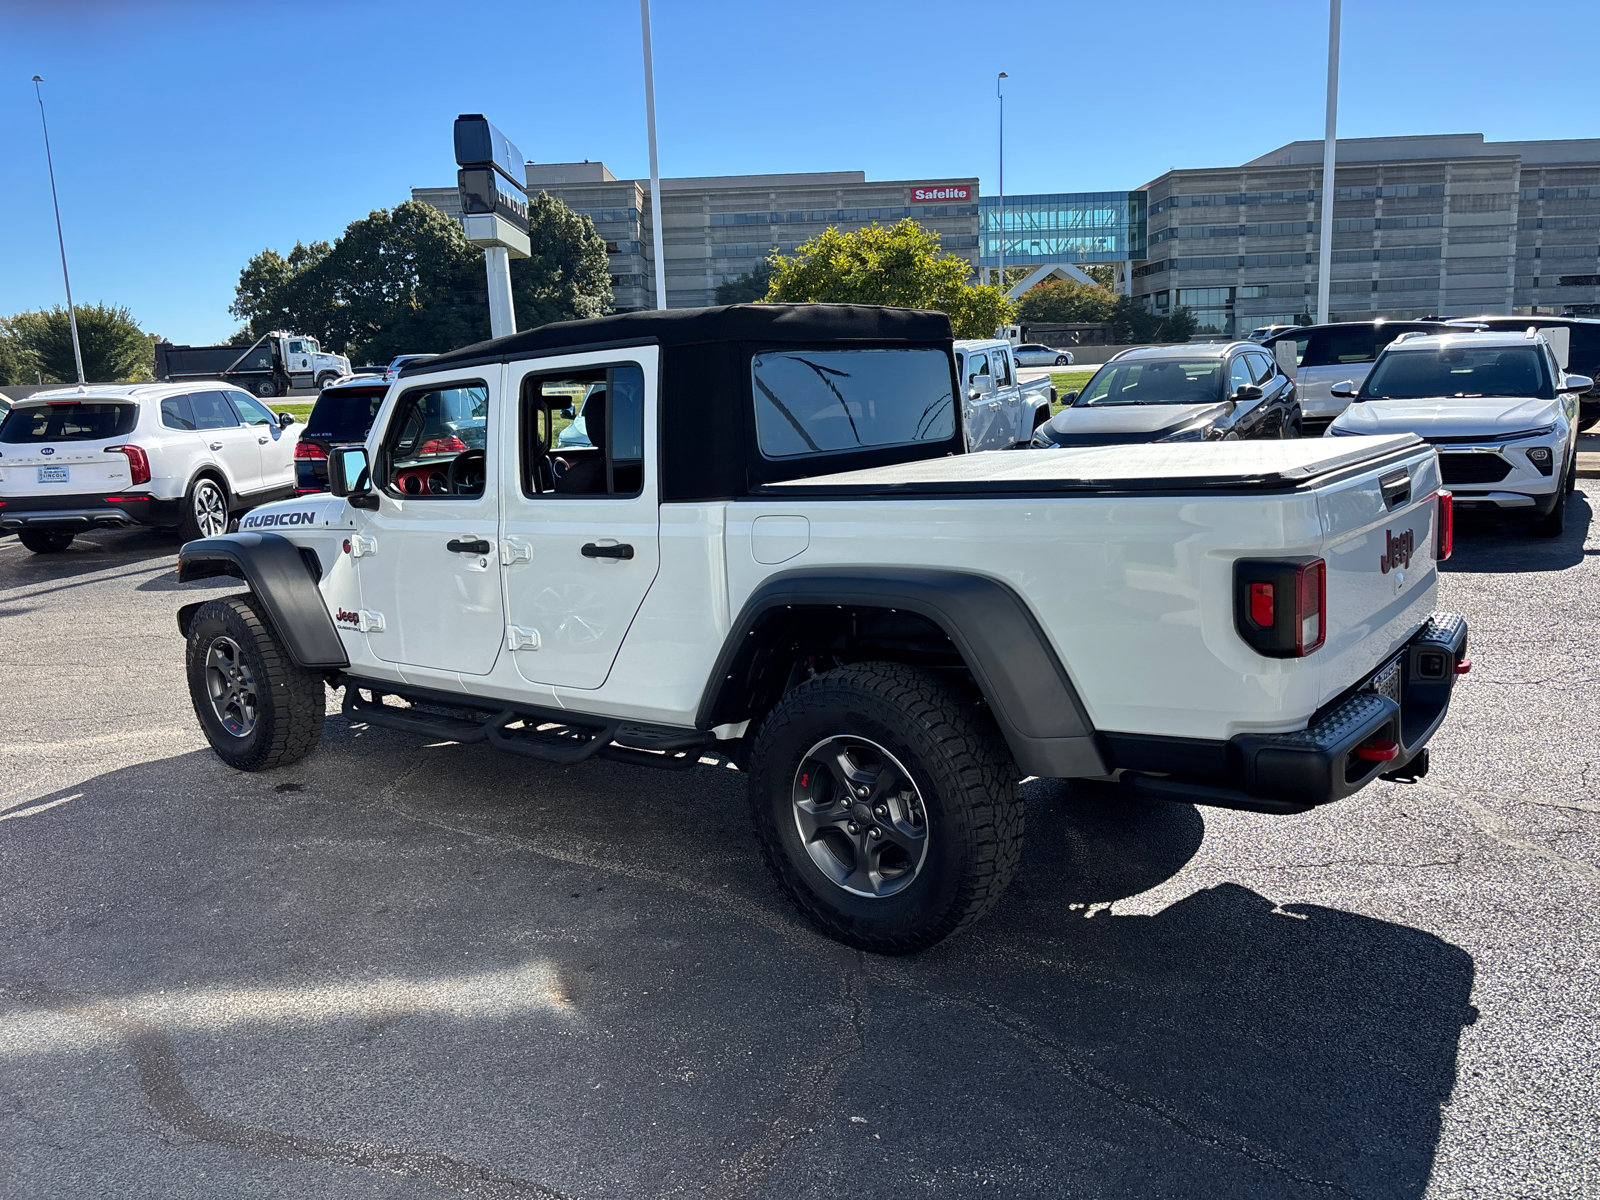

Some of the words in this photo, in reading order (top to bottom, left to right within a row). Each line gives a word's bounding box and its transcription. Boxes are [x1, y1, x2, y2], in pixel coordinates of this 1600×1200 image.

[498, 184, 528, 220] LINCOLN
[915, 188, 967, 200] Safelite
[244, 512, 316, 528] RUBICON
[1380, 528, 1414, 574] Jeep
[336, 607, 360, 626] Jeep
